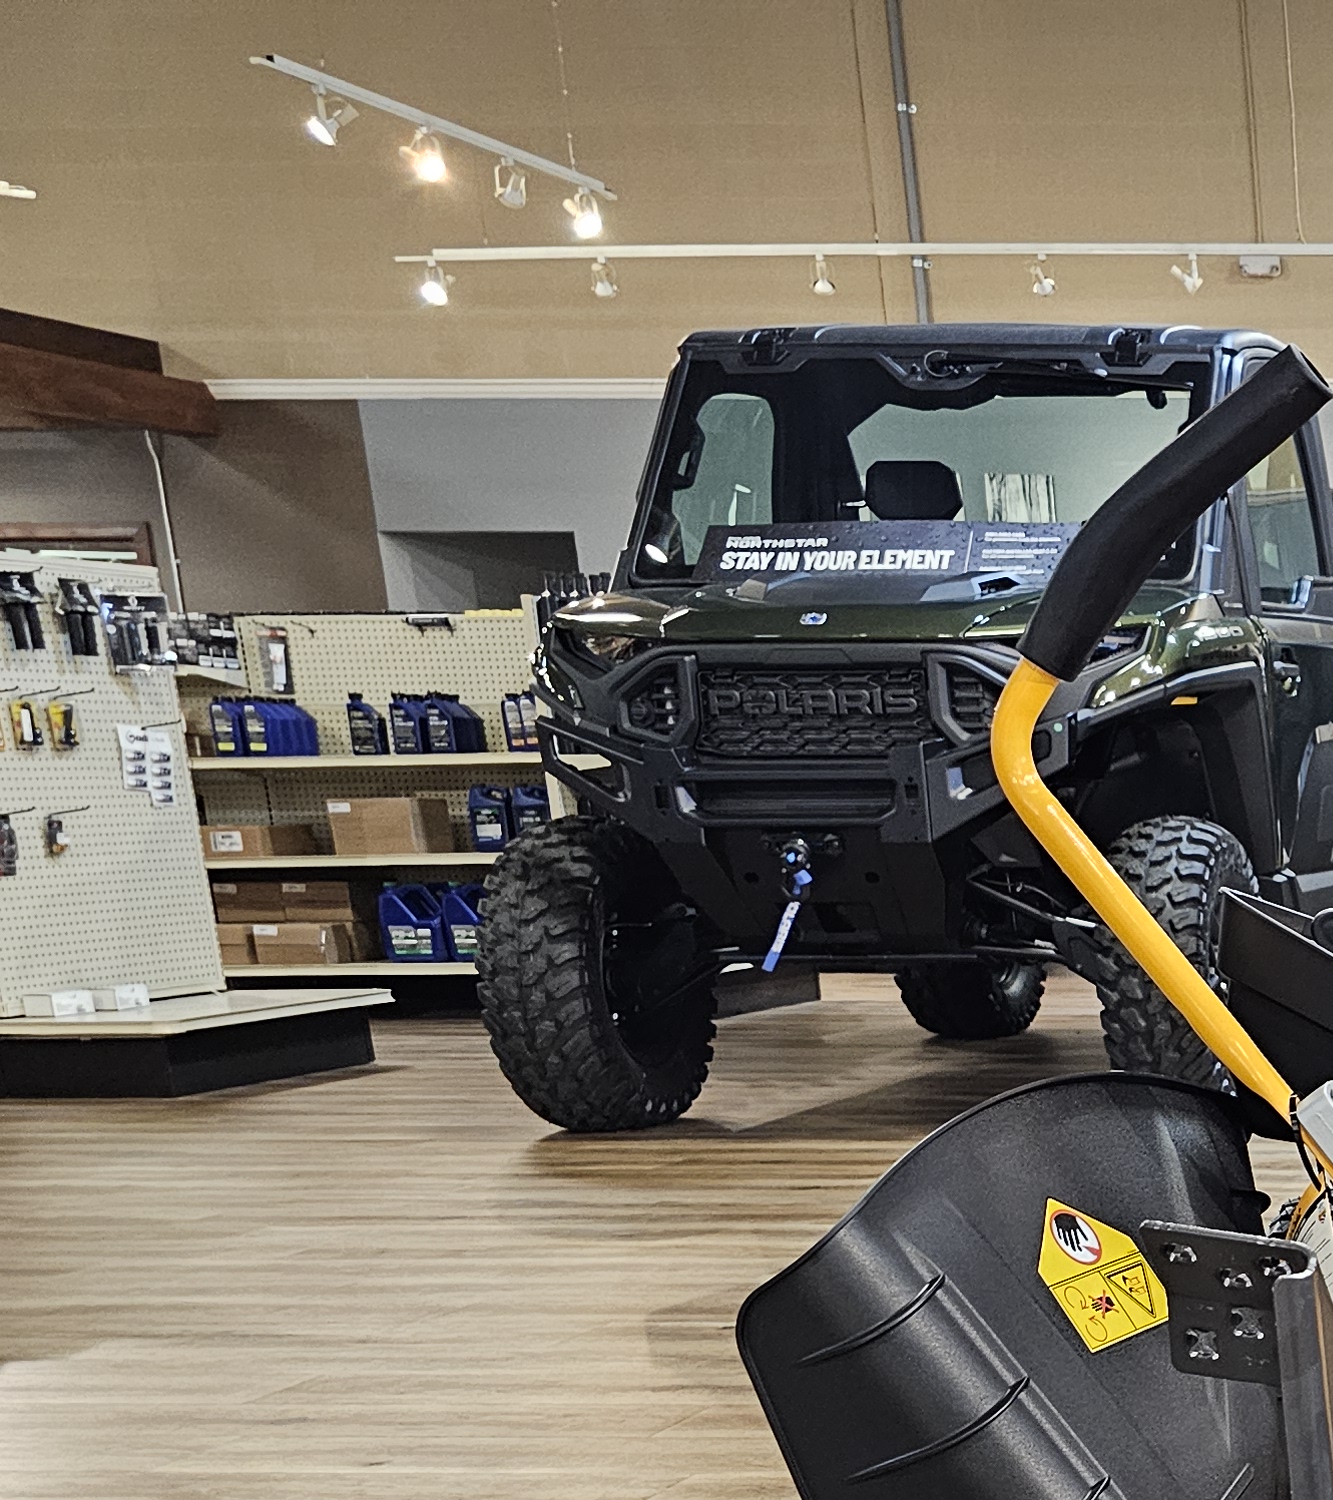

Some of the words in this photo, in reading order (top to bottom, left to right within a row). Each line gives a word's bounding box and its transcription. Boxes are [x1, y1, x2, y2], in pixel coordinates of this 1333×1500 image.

[719, 551, 775, 570] STAY
[774, 551, 801, 571] IN
[803, 550, 857, 571] YOUR
[857, 549, 956, 570] ELEMENT
[707, 688, 918, 715] POLARIS
